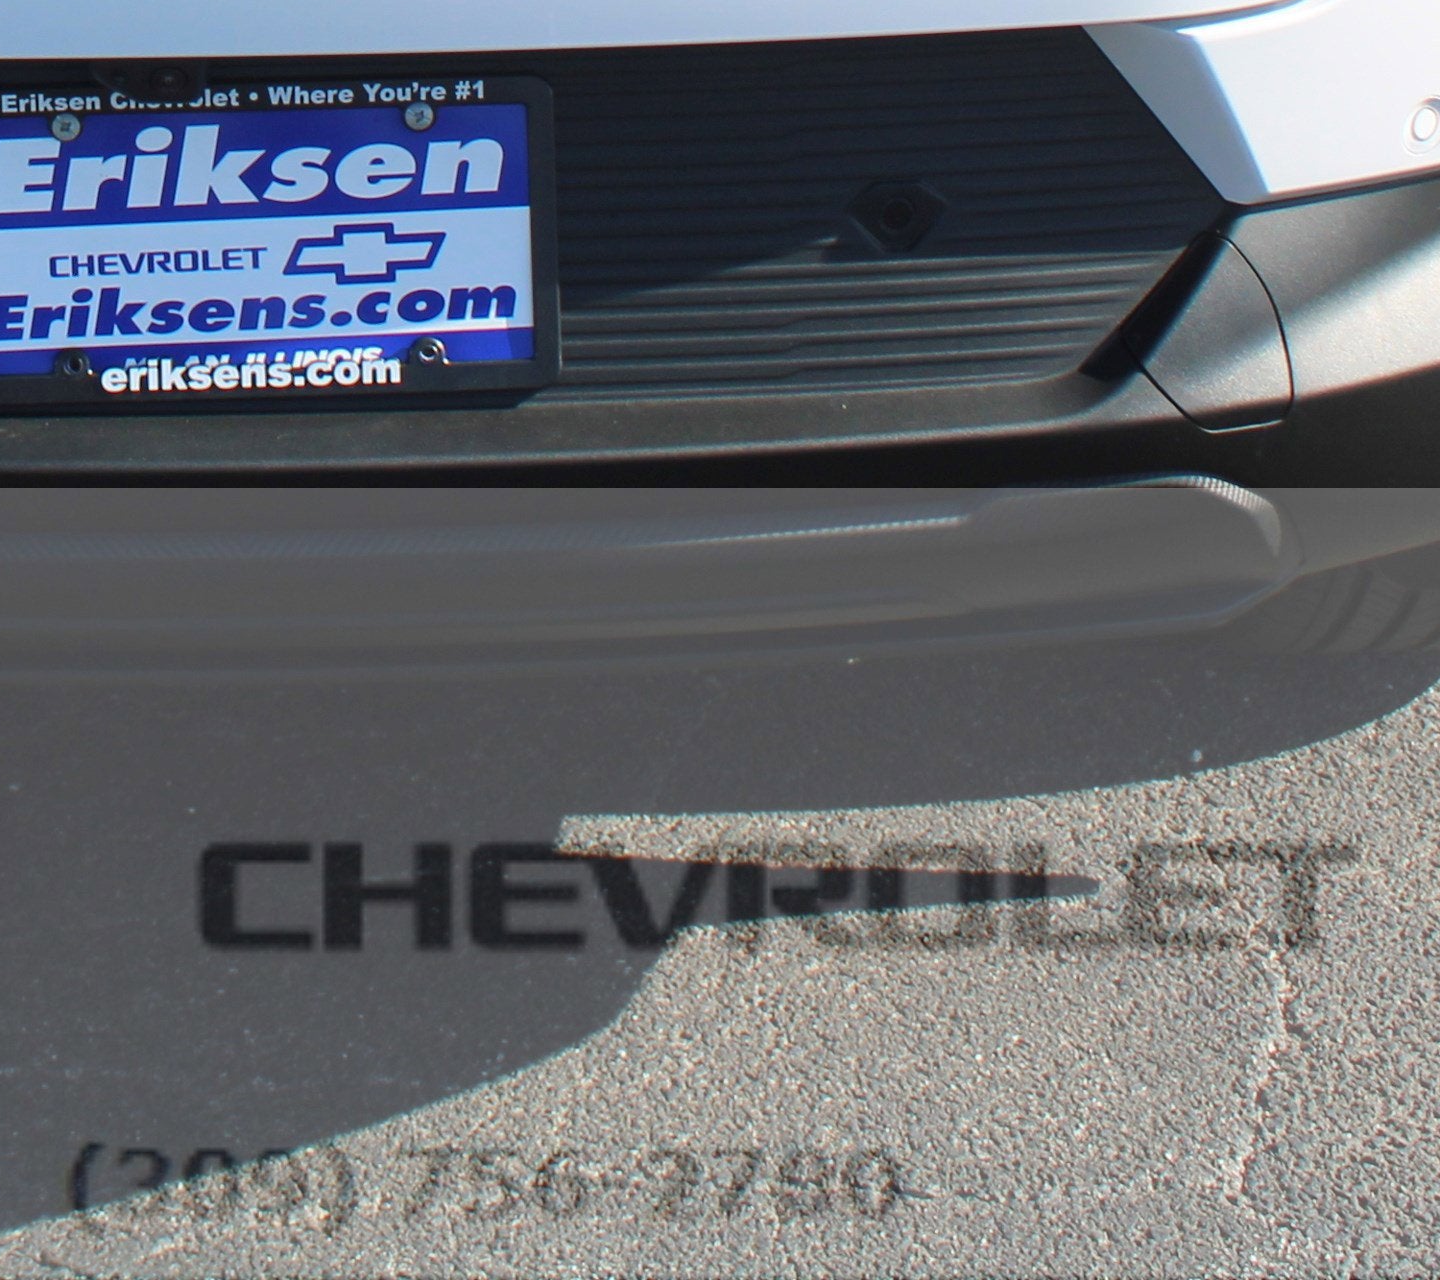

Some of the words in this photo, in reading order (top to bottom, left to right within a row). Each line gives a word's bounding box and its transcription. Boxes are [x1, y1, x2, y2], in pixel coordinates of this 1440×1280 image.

[1, 93, 101, 114] Eriksen
[268, 84, 355, 106] Where
[363, 81, 447, 103] You're
[455, 80, 485, 100] #1
[49, 247, 268, 278] CHEVROLET
[101, 356, 401, 392] eriksens.com
